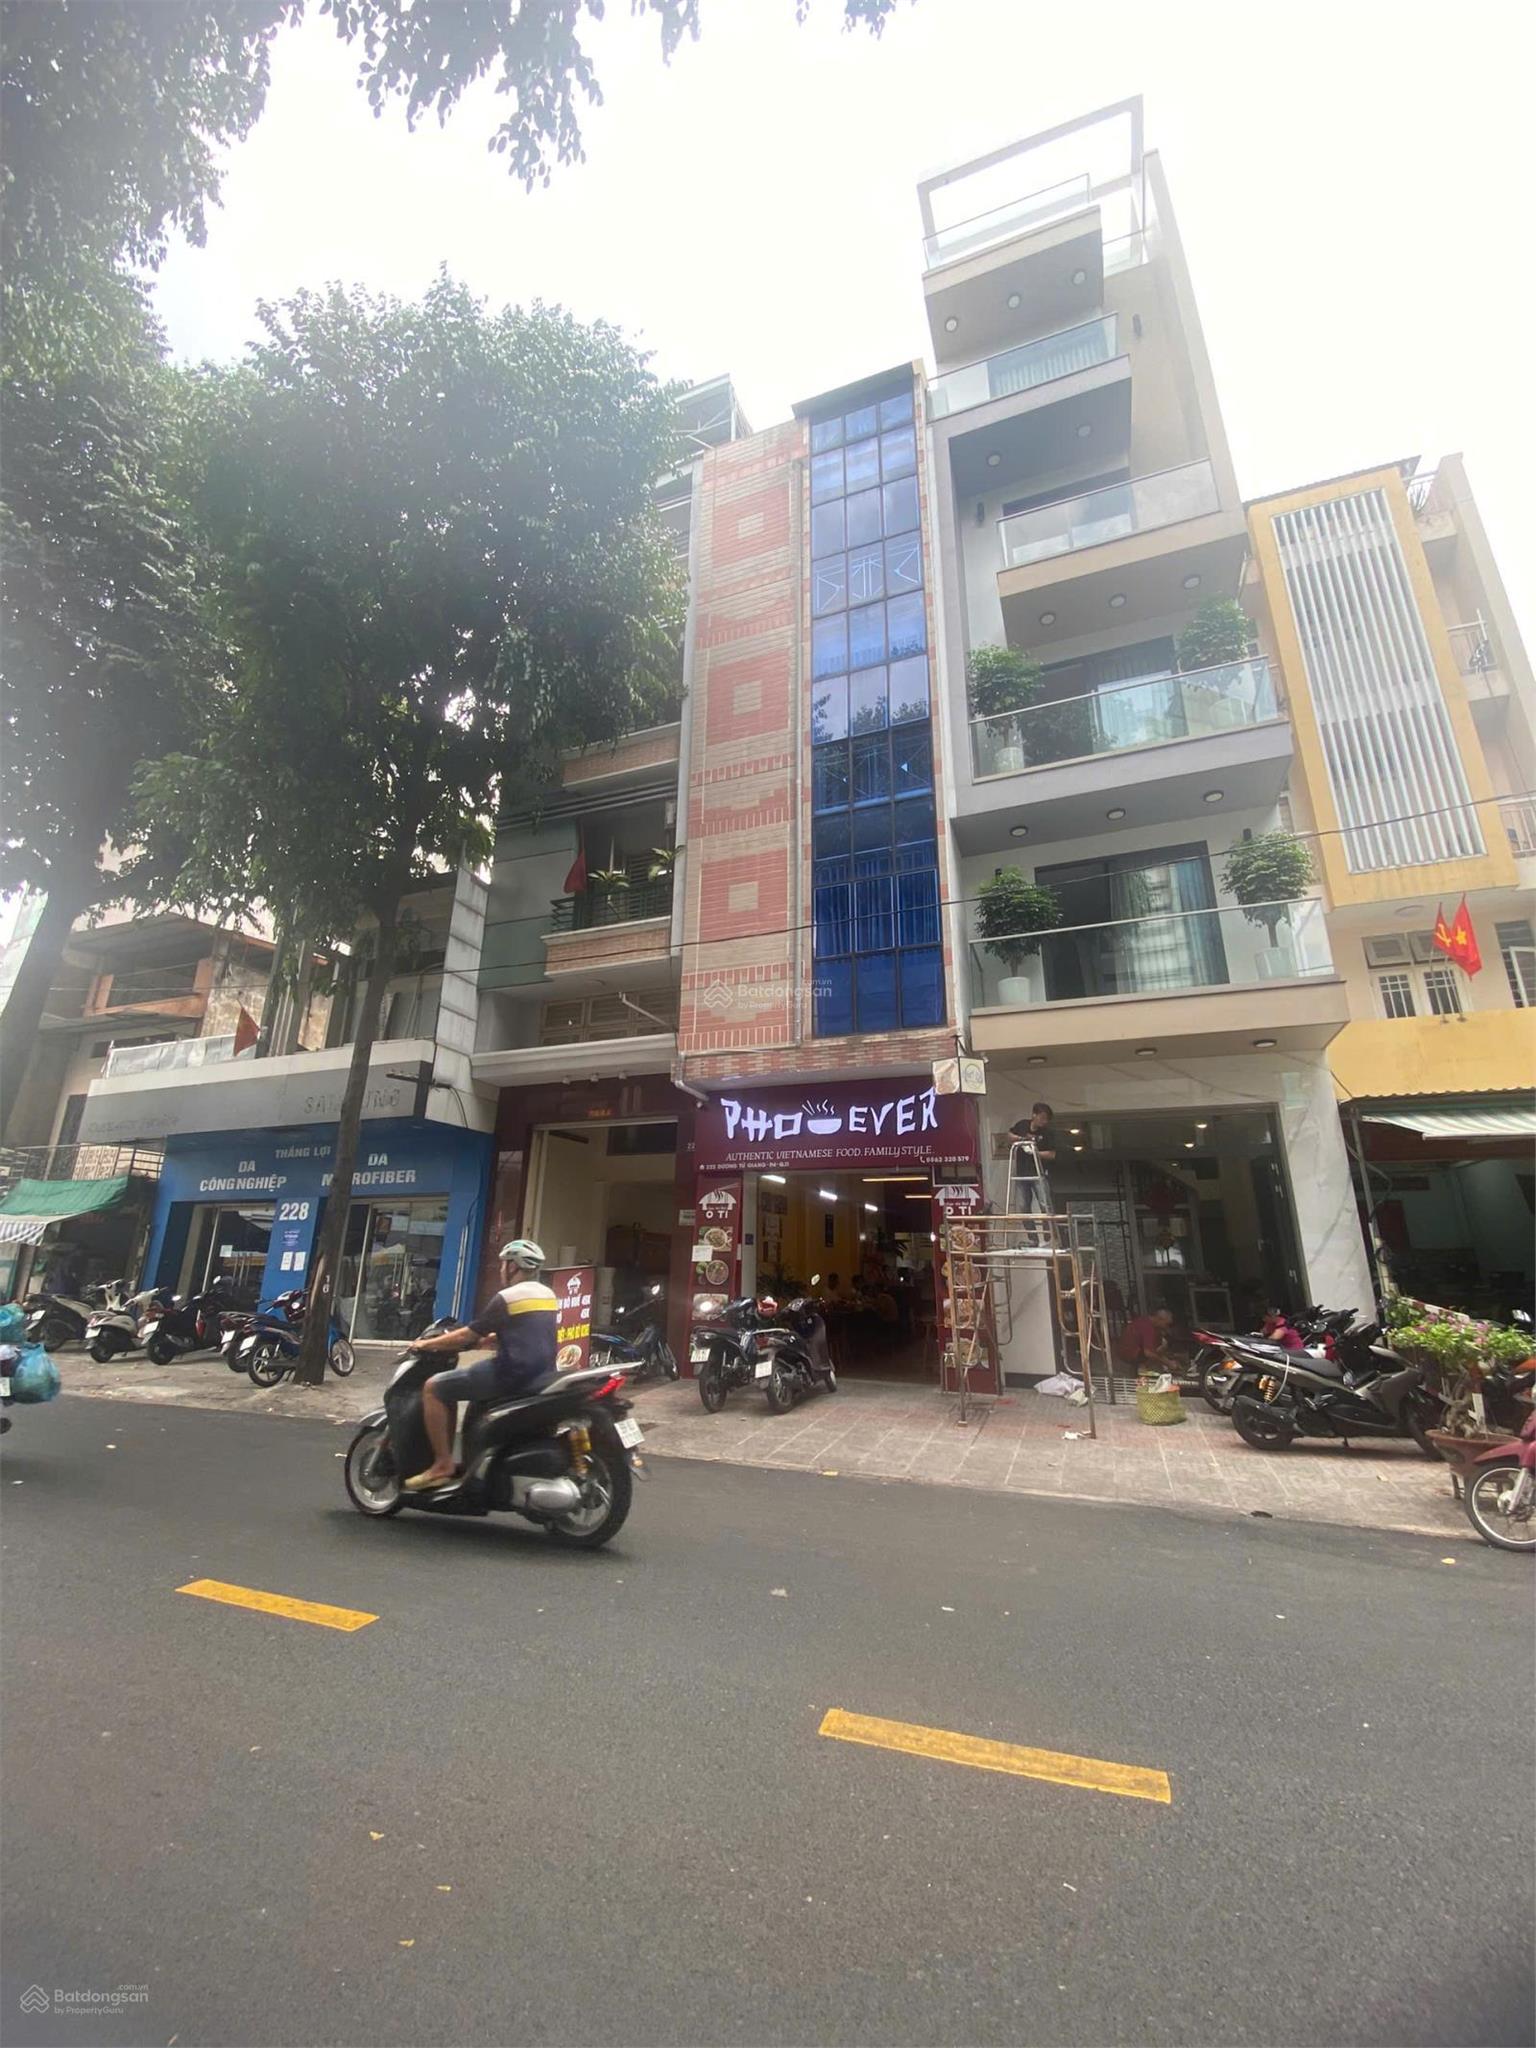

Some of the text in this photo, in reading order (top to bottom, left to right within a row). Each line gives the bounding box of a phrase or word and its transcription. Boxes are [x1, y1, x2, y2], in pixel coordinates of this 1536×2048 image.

[720, 1086, 938, 1142] PHO EVER
[367, 1153, 388, 1166] DA
[725, 1151, 775, 1161] AUTHENTIC
[776, 1149, 833, 1159] VIETNAMESE
[238, 1160, 256, 1173] DA
[279, 1202, 309, 1220] 228
